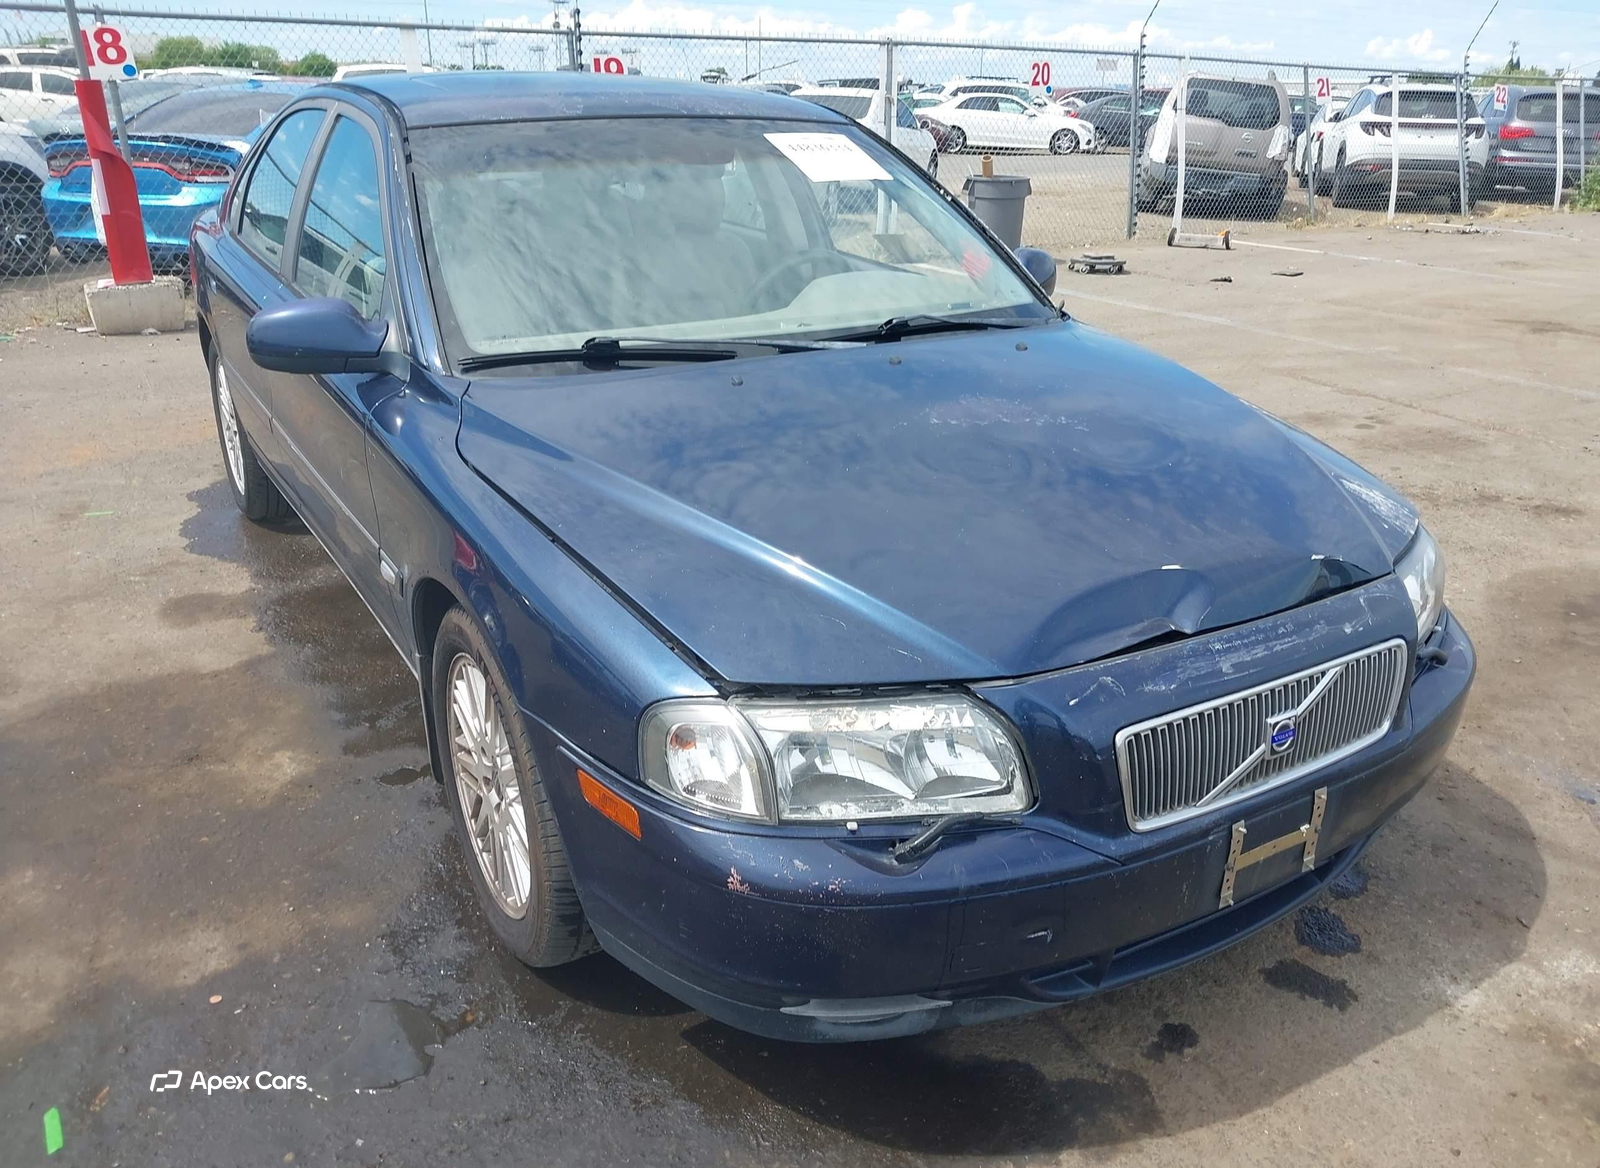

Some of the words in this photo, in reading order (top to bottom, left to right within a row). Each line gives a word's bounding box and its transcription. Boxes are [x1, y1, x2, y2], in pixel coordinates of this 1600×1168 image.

[81, 27, 127, 67] 18
[1031, 62, 1050, 86] 20
[1316, 78, 1330, 97] 21
[1496, 86, 1507, 104] 22
[1274, 730, 1294, 742] VOLVO
